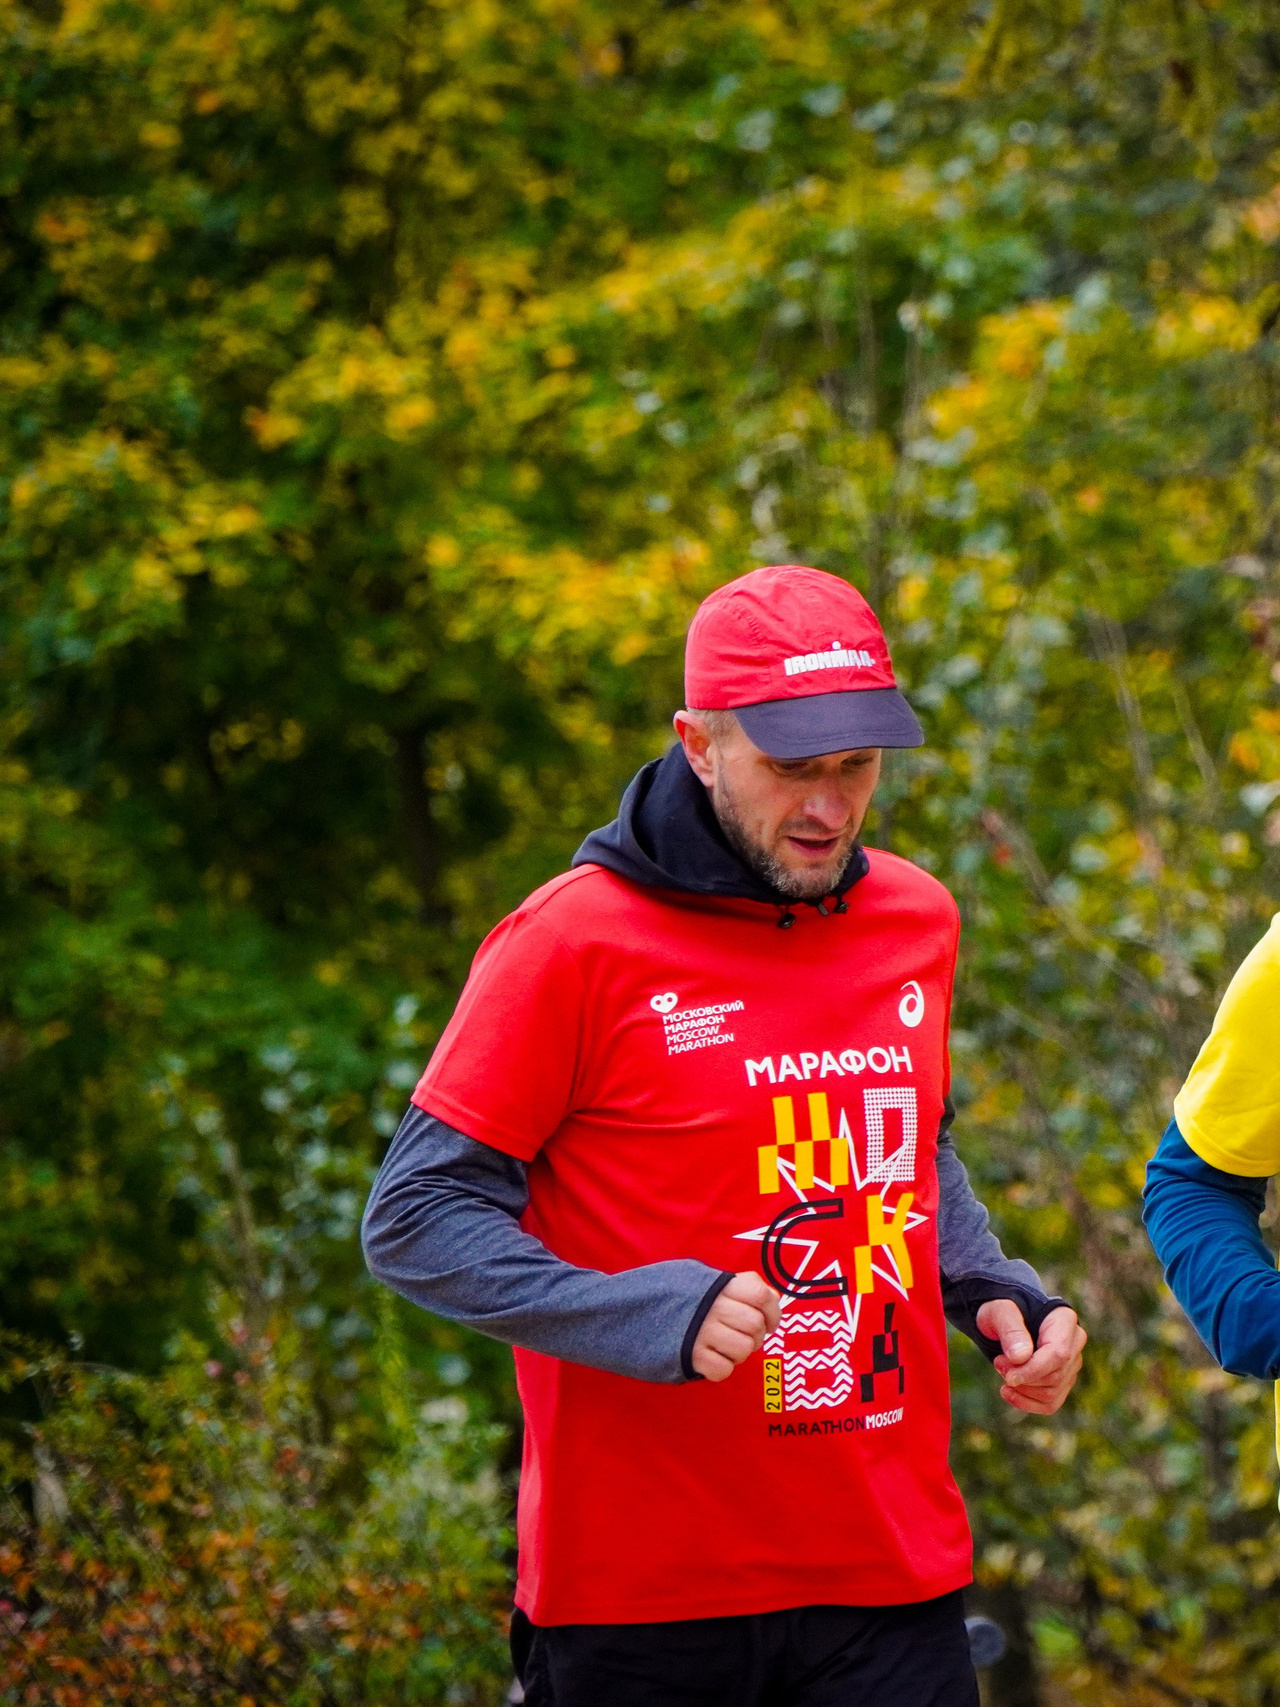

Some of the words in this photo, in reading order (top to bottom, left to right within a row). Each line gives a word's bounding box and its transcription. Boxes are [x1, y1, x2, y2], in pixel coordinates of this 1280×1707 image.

[784, 641, 873, 676] IRONMAN
[662, 1000, 745, 1024] МОСКОВСКИЙ
[664, 1015, 725, 1034] МАРАФОН
[666, 1025, 720, 1045] MOSCOW
[668, 1033, 734, 1055] MARATHON
[744, 1046, 913, 1087] МАРАФОН
[766, 1361, 781, 1410] 2022
